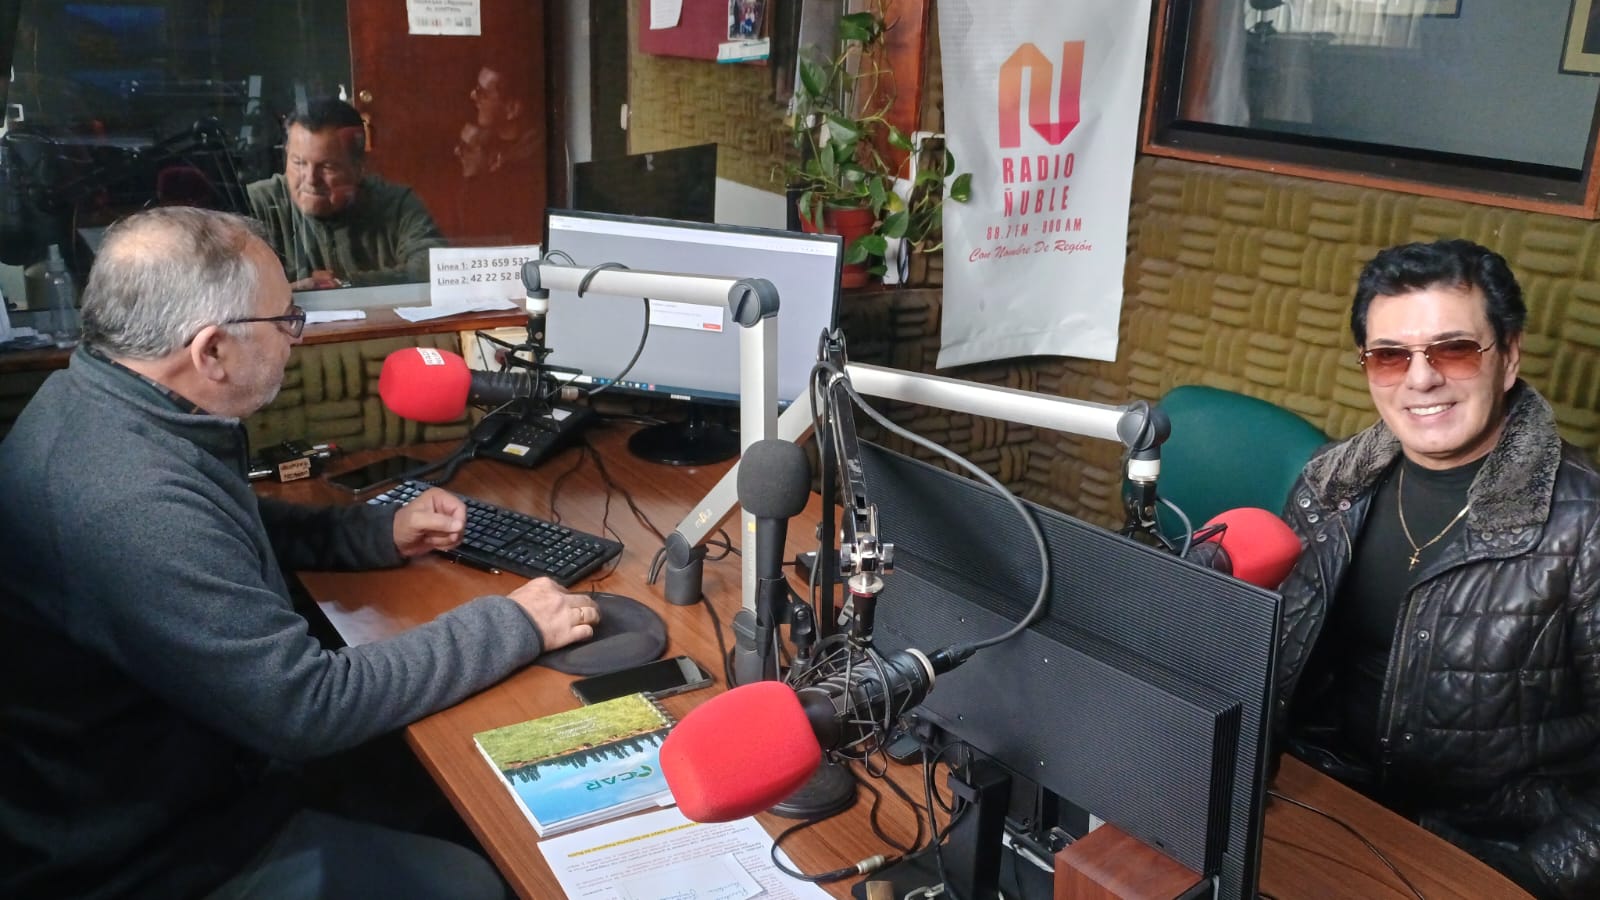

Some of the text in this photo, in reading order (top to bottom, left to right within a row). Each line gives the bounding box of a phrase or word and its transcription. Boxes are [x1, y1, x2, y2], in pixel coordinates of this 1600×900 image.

[1003, 153, 1074, 183] RADIO
[1004, 185, 1069, 217] ÑUBLE
[1064, 217, 1082, 233] AM
[969, 240, 1092, 262] Con Nombre De Región
[471, 260, 489, 269] 233
[492, 258, 510, 268] 659
[485, 273, 497, 281] 22
[501, 272, 512, 281] 52
